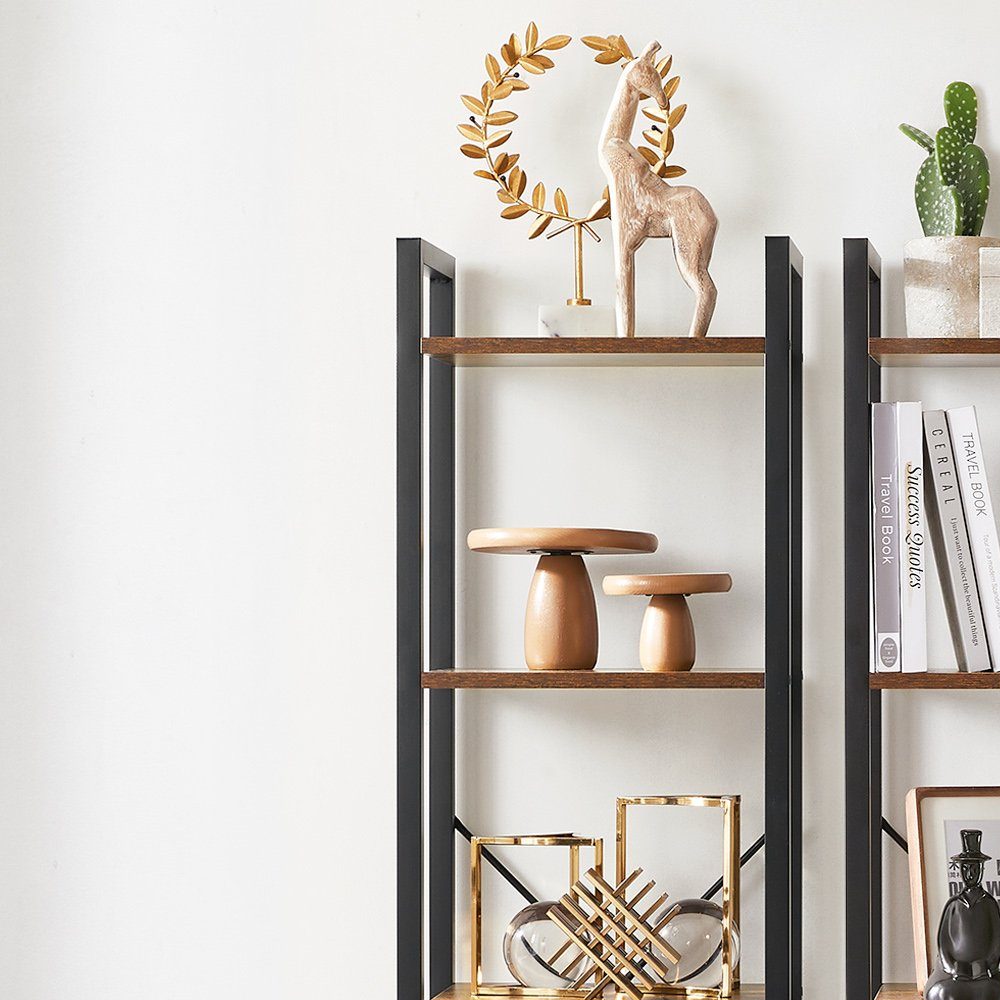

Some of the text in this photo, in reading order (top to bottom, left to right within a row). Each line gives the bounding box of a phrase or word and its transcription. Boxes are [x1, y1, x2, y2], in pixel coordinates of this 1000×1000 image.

[931, 428, 956, 505] CEREAL
[962, 432, 988, 517] TRAVEL BOOK
[880, 473, 894, 565] Travel Book
[905, 462, 924, 589] Success Quotes
[950, 521, 959, 534] just
[957, 552, 963, 560] to
[959, 561, 968, 582] collect
[965, 594, 977, 625] beautiful
[970, 625, 979, 647] things
